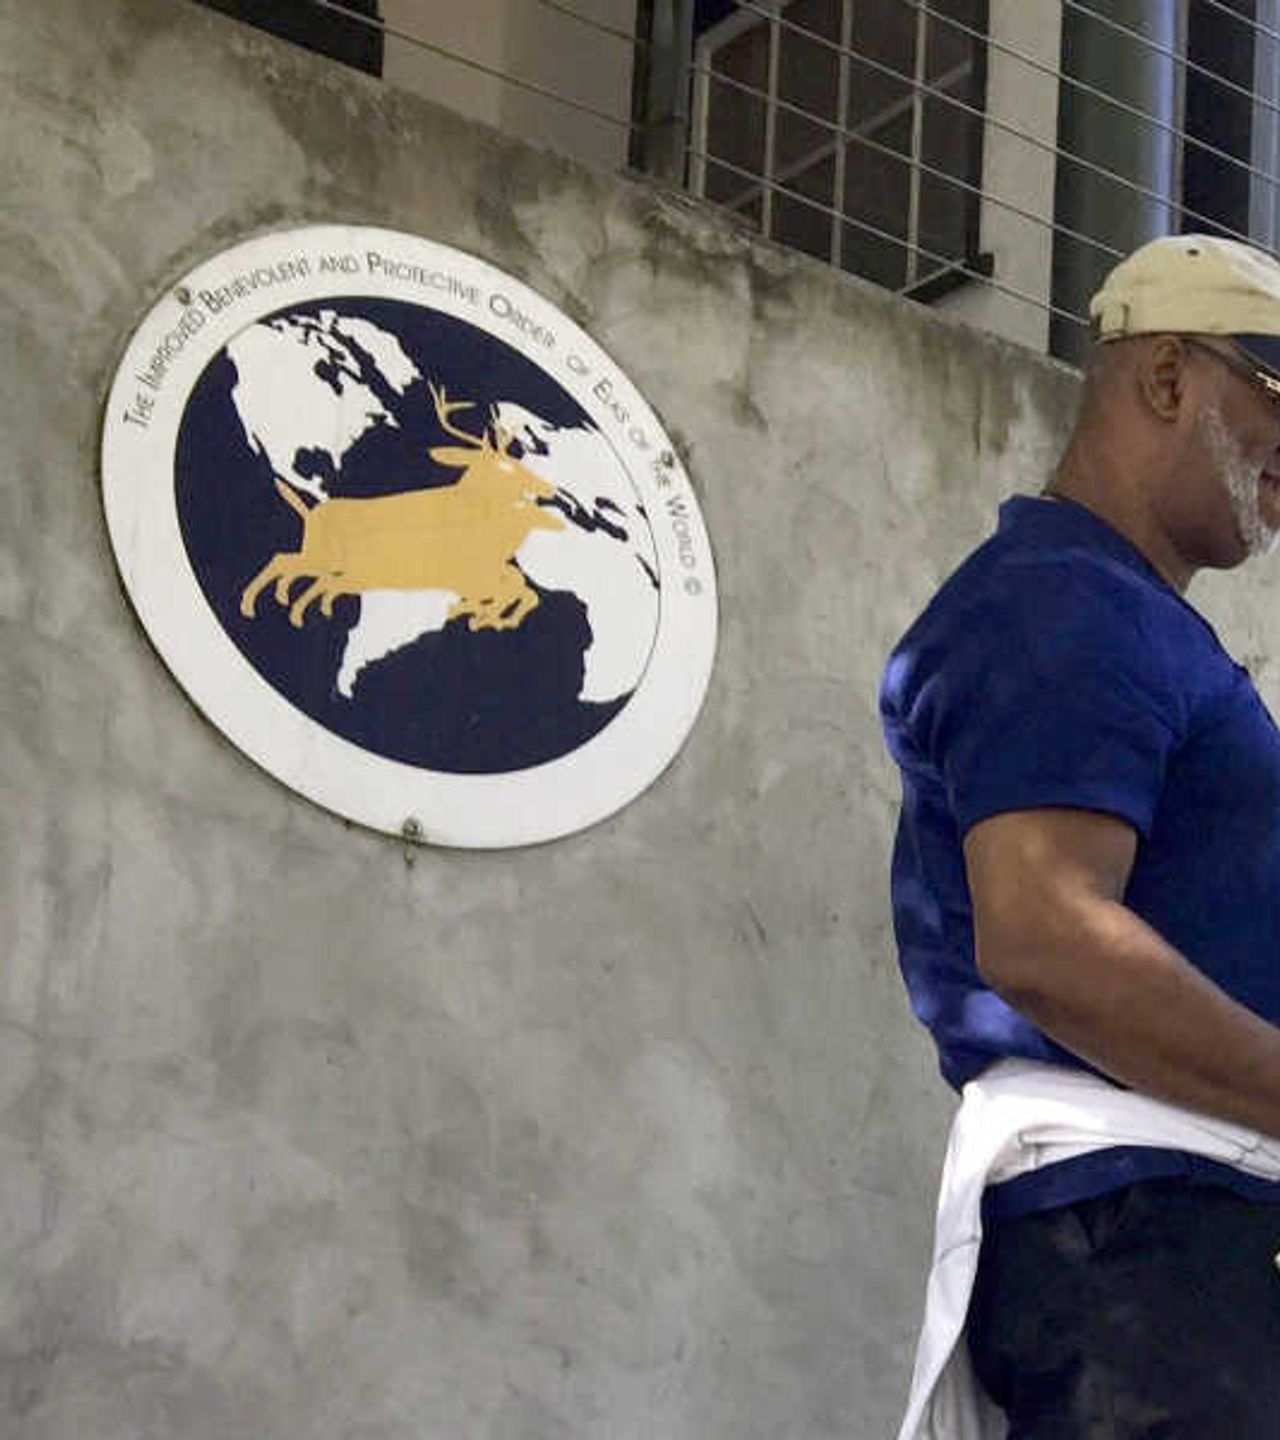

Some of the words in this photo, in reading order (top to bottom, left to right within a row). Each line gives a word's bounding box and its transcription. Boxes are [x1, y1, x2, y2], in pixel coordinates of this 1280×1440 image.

[200, 256, 311, 315] BENEVOLENT
[319, 255, 360, 274] AND
[367, 252, 481, 304] PROTECTIVE
[489, 294, 557, 348] ORDER
[135, 307, 206, 390] IMPROVED
[122, 391, 155, 427] THE
[666, 496, 698, 570] WORLD
